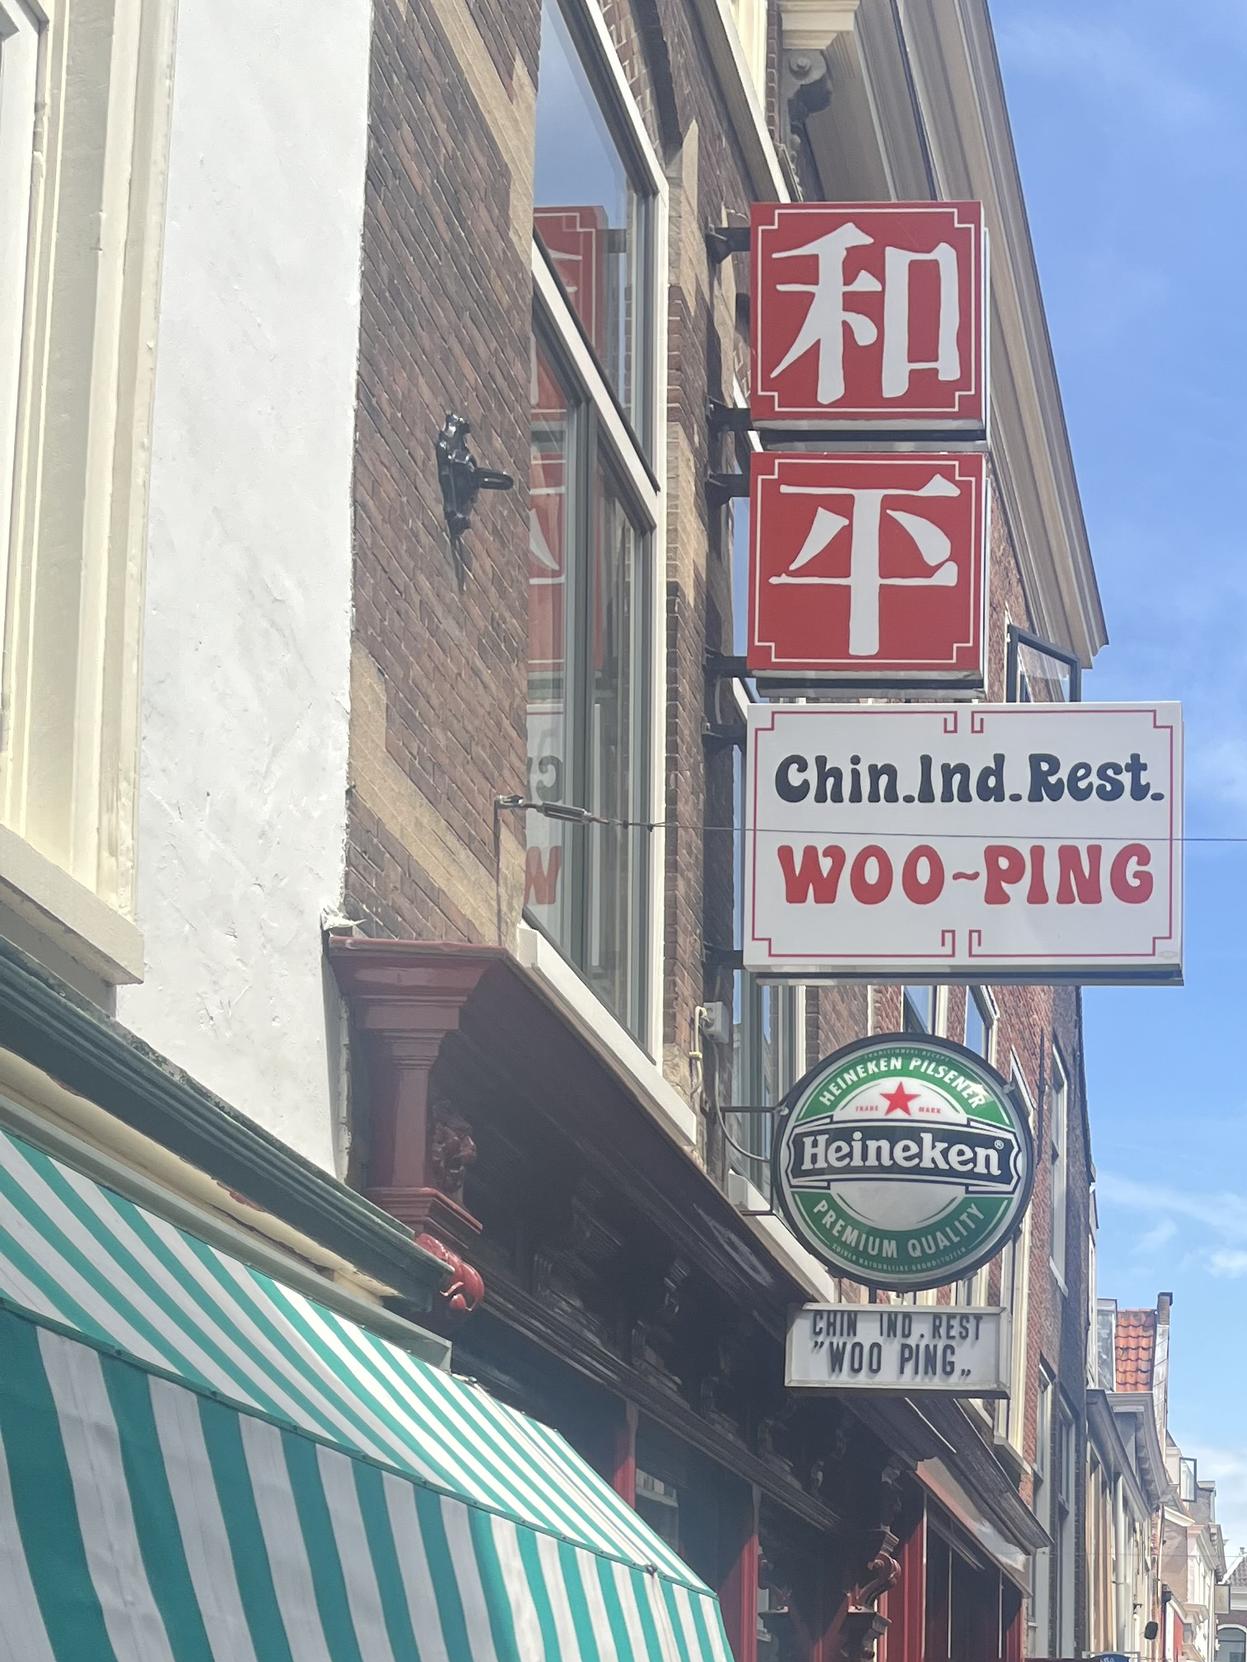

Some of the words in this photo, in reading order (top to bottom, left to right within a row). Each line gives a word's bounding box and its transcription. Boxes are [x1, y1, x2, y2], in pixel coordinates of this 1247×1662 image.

[775, 753, 1165, 803] Chin.Ind.Rest.
[819, 1057, 902, 1107] HEINEKEN
[909, 1057, 987, 1109] PILSENER
[918, 1106, 941, 1114] MARK
[801, 1131, 1002, 1176] Heineken
[813, 1199, 898, 1259] PREMIUM
[907, 1203, 985, 1258] QUALITY
[812, 1311, 858, 1337] CHIN
